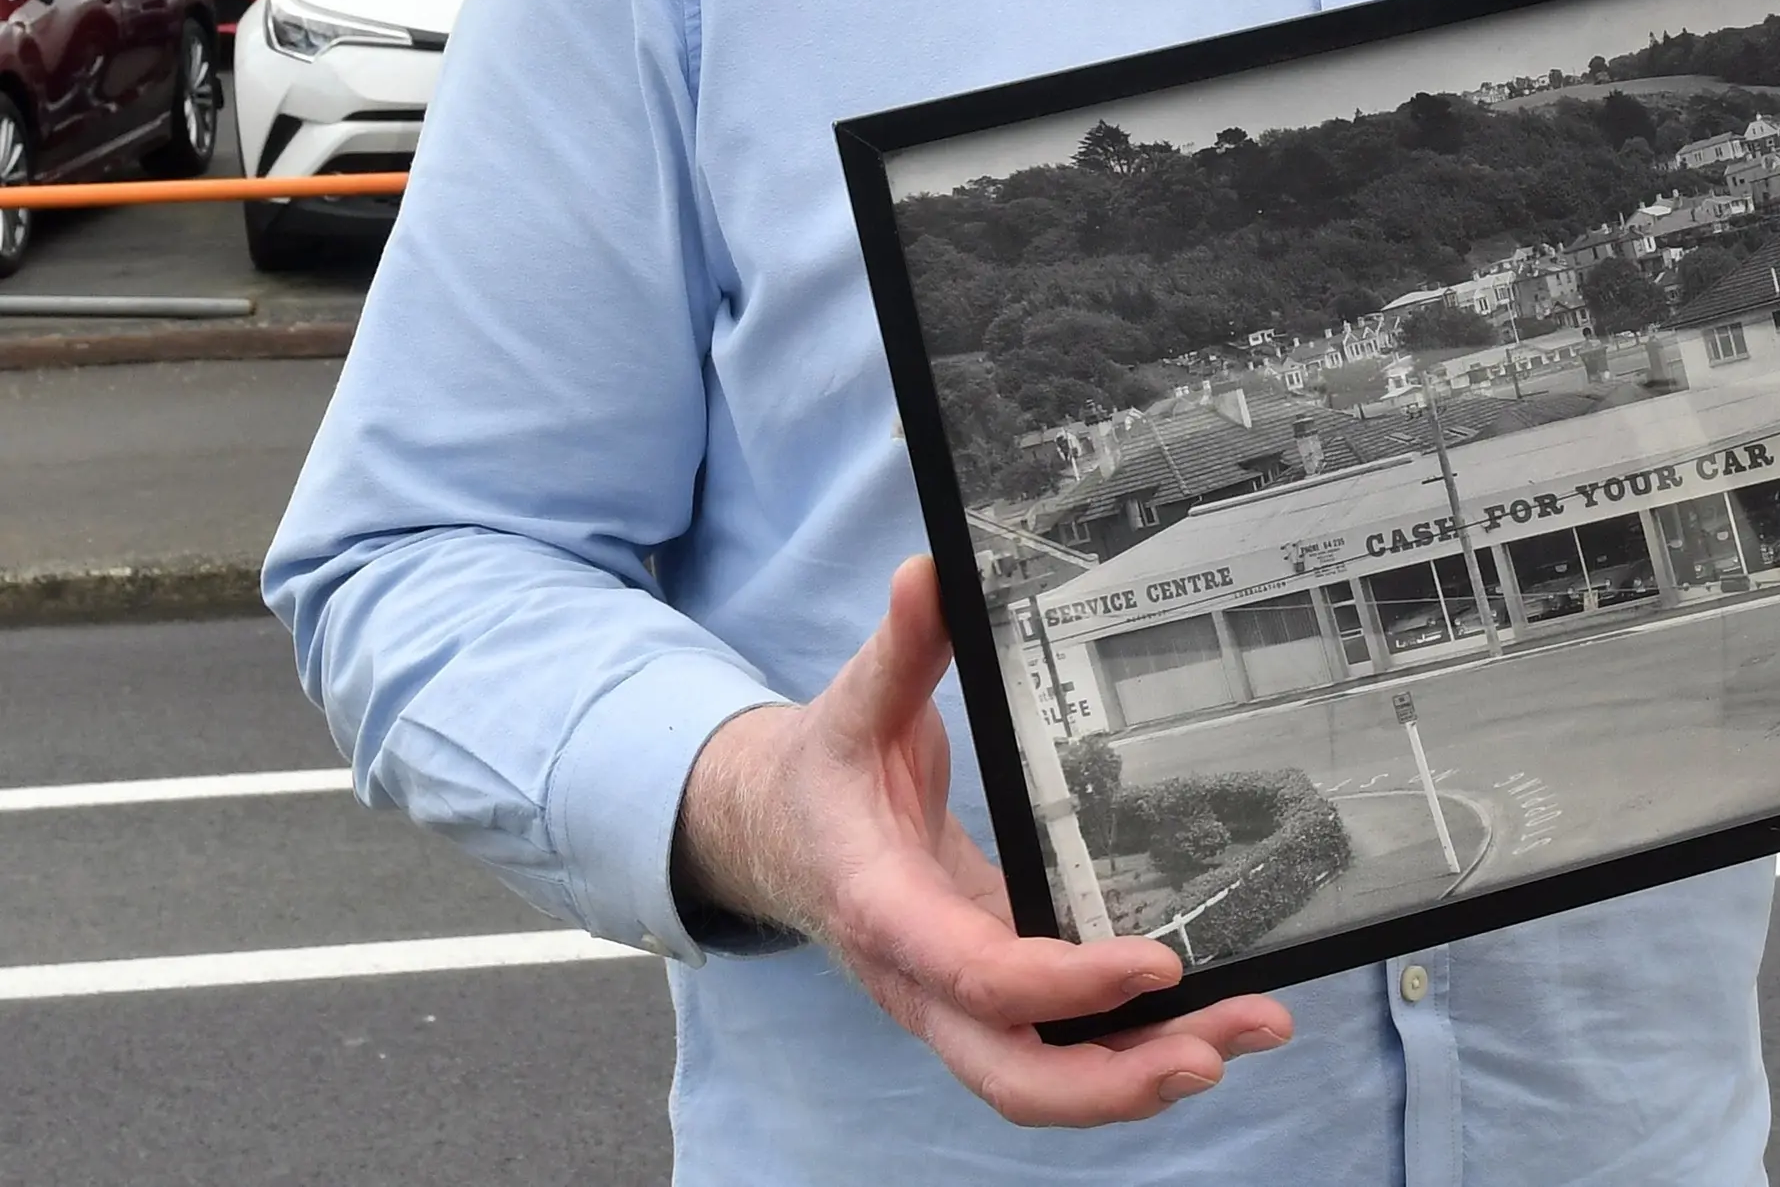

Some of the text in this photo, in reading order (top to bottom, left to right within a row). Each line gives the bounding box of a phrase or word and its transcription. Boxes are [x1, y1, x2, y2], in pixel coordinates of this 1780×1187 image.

[1365, 443, 1775, 557] CASH FOR YOUR CAR
[1045, 590, 1138, 627] SERVICE
[1146, 566, 1234, 603] CENTRE
